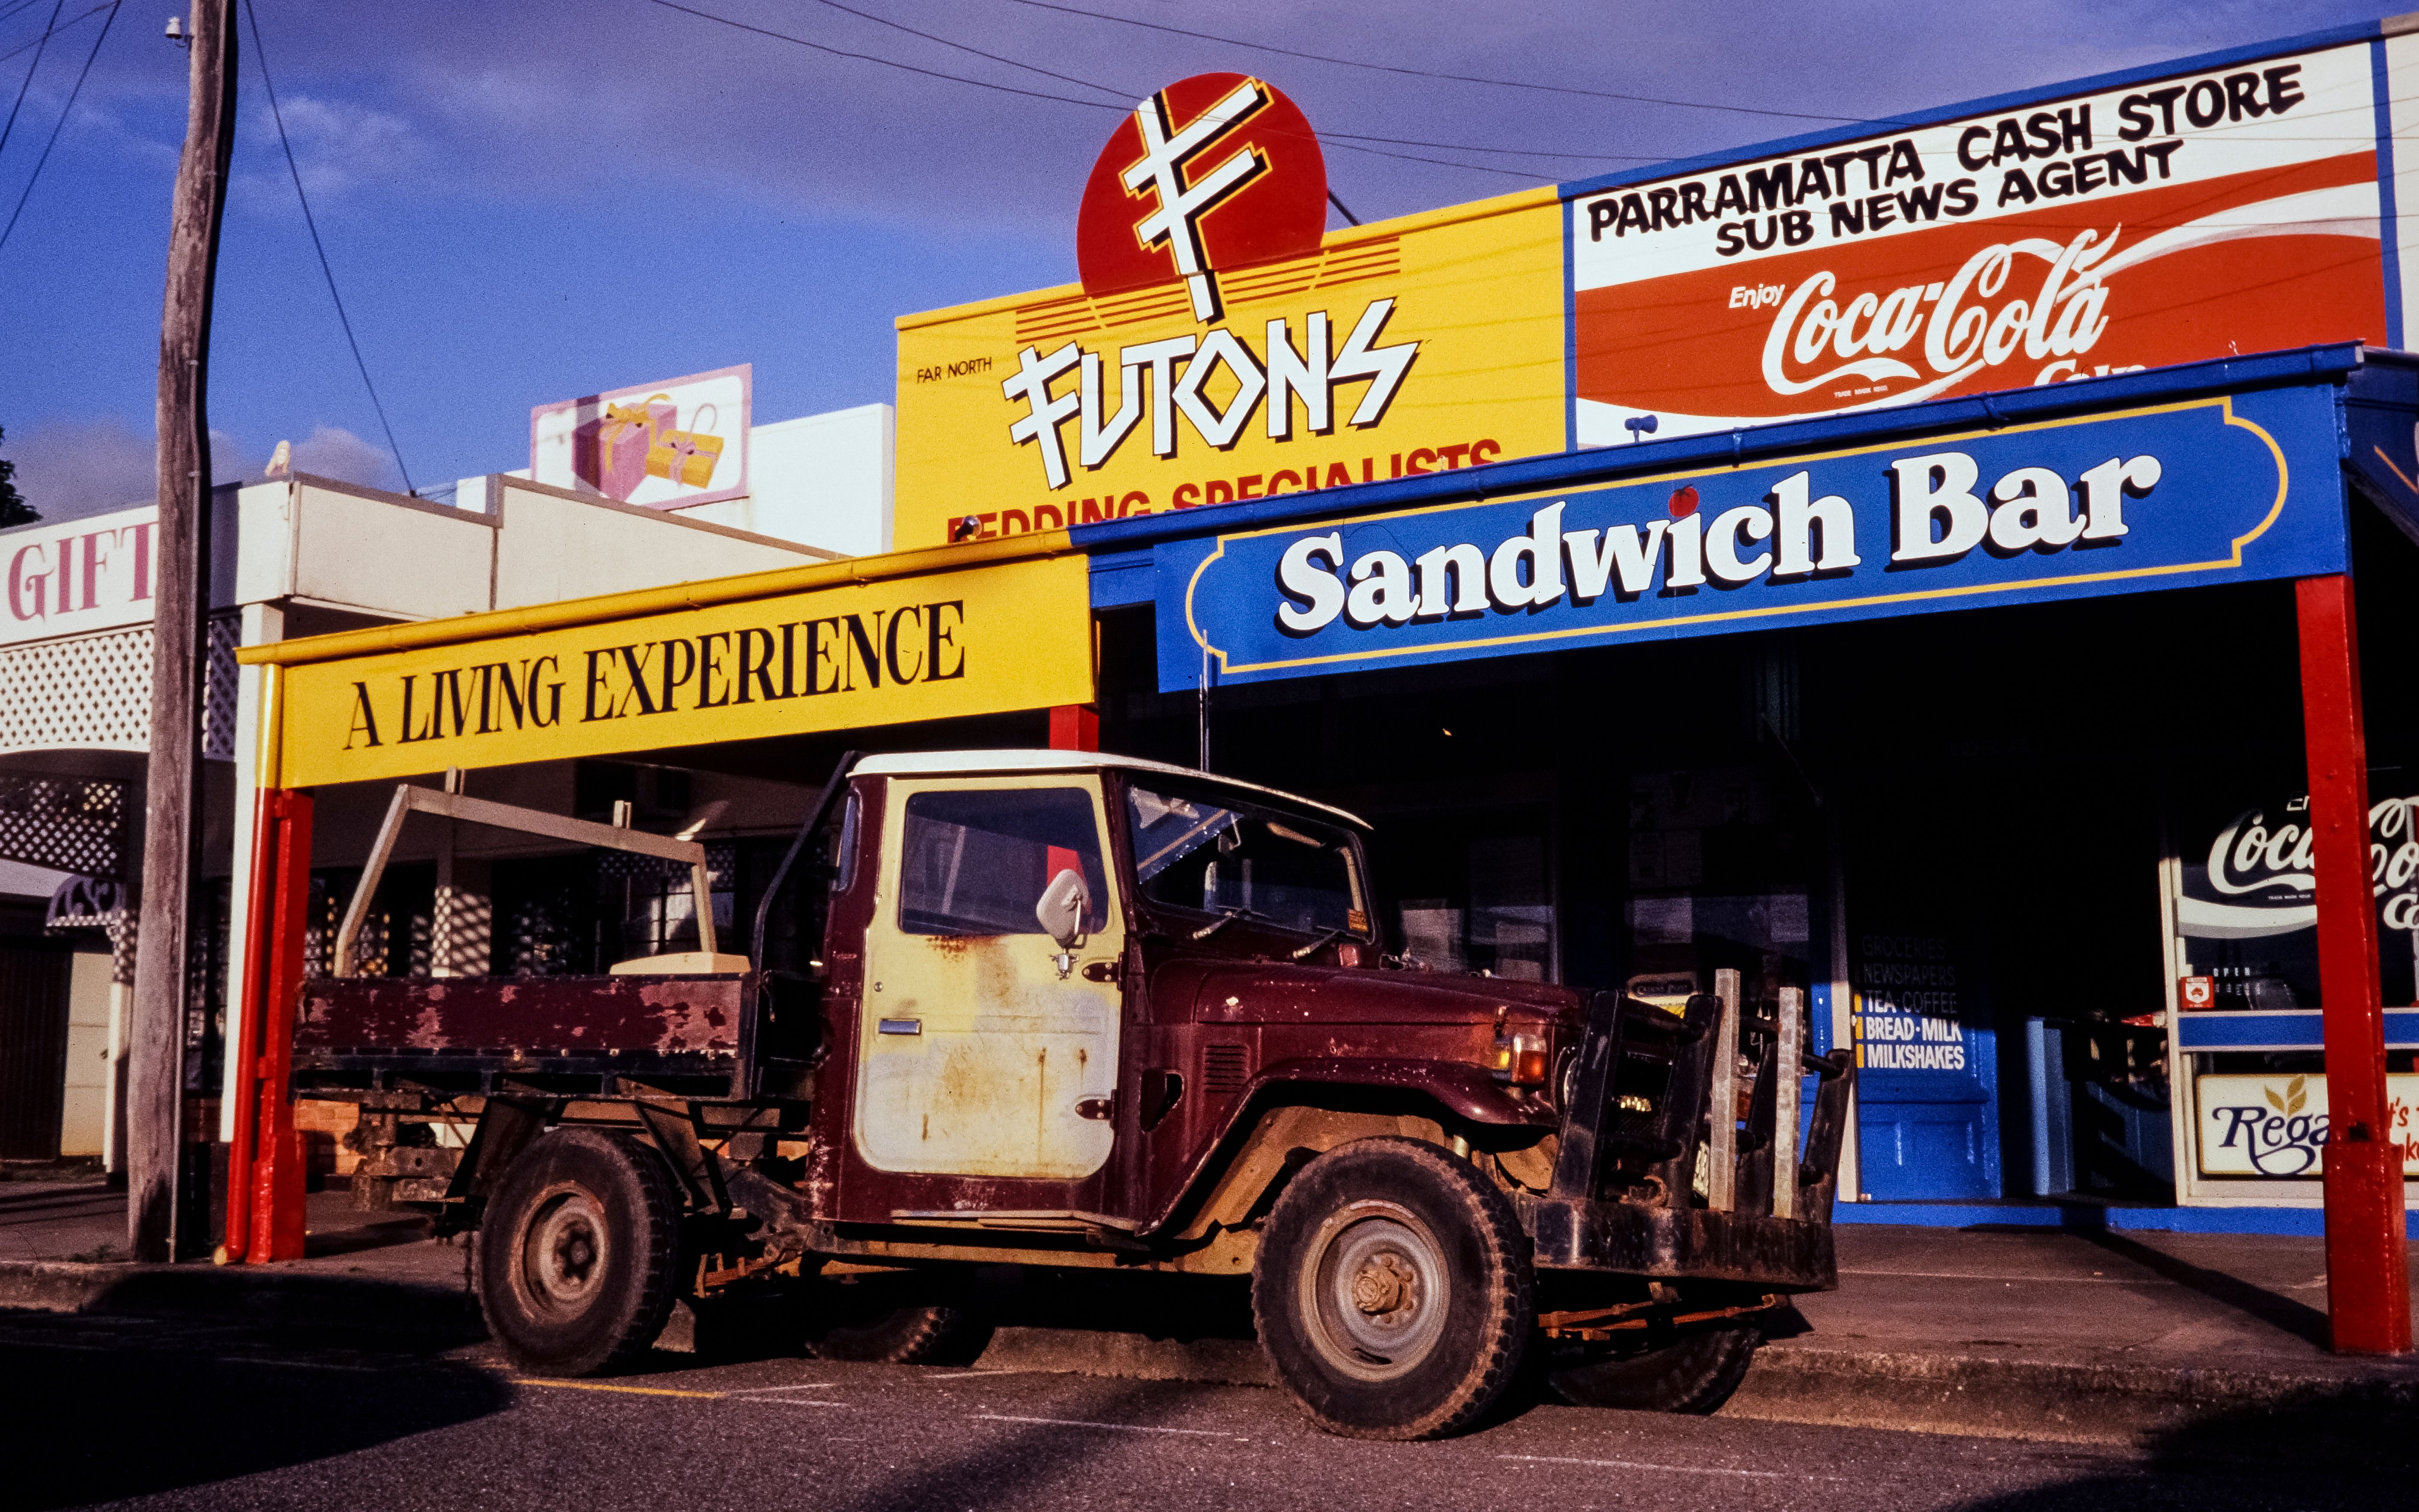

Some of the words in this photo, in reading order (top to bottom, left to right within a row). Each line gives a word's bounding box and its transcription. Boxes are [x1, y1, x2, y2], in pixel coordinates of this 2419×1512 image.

[1588, 138, 1925, 242] PARRAMATTA
[1957, 103, 2093, 171] CASH
[2118, 64, 2305, 141] STORE
[1716, 210, 1814, 256] SUB
[1829, 179, 1979, 237] NEWS
[1997, 139, 2184, 208] AGENT
[1729, 283, 1785, 309] Enjoy
[1761, 222, 2121, 395] Coca-Cola
[917, 366, 942, 384] FAR
[948, 356, 992, 378] NORTH
[1001, 296, 1422, 490] FUTONS
[1276, 470, 1861, 635] Sandwich
[1887, 452, 2162, 566] Bar
[342, 682, 384, 750] A
[397, 654, 566, 744] LIVING
[580, 599, 966, 722] EXPERIENCE
[1862, 934, 1946, 960] GROCERIES
[1863, 962, 1957, 987] NEWSPAPERS
[1867, 1044, 1965, 1070] MILKSHAKES
